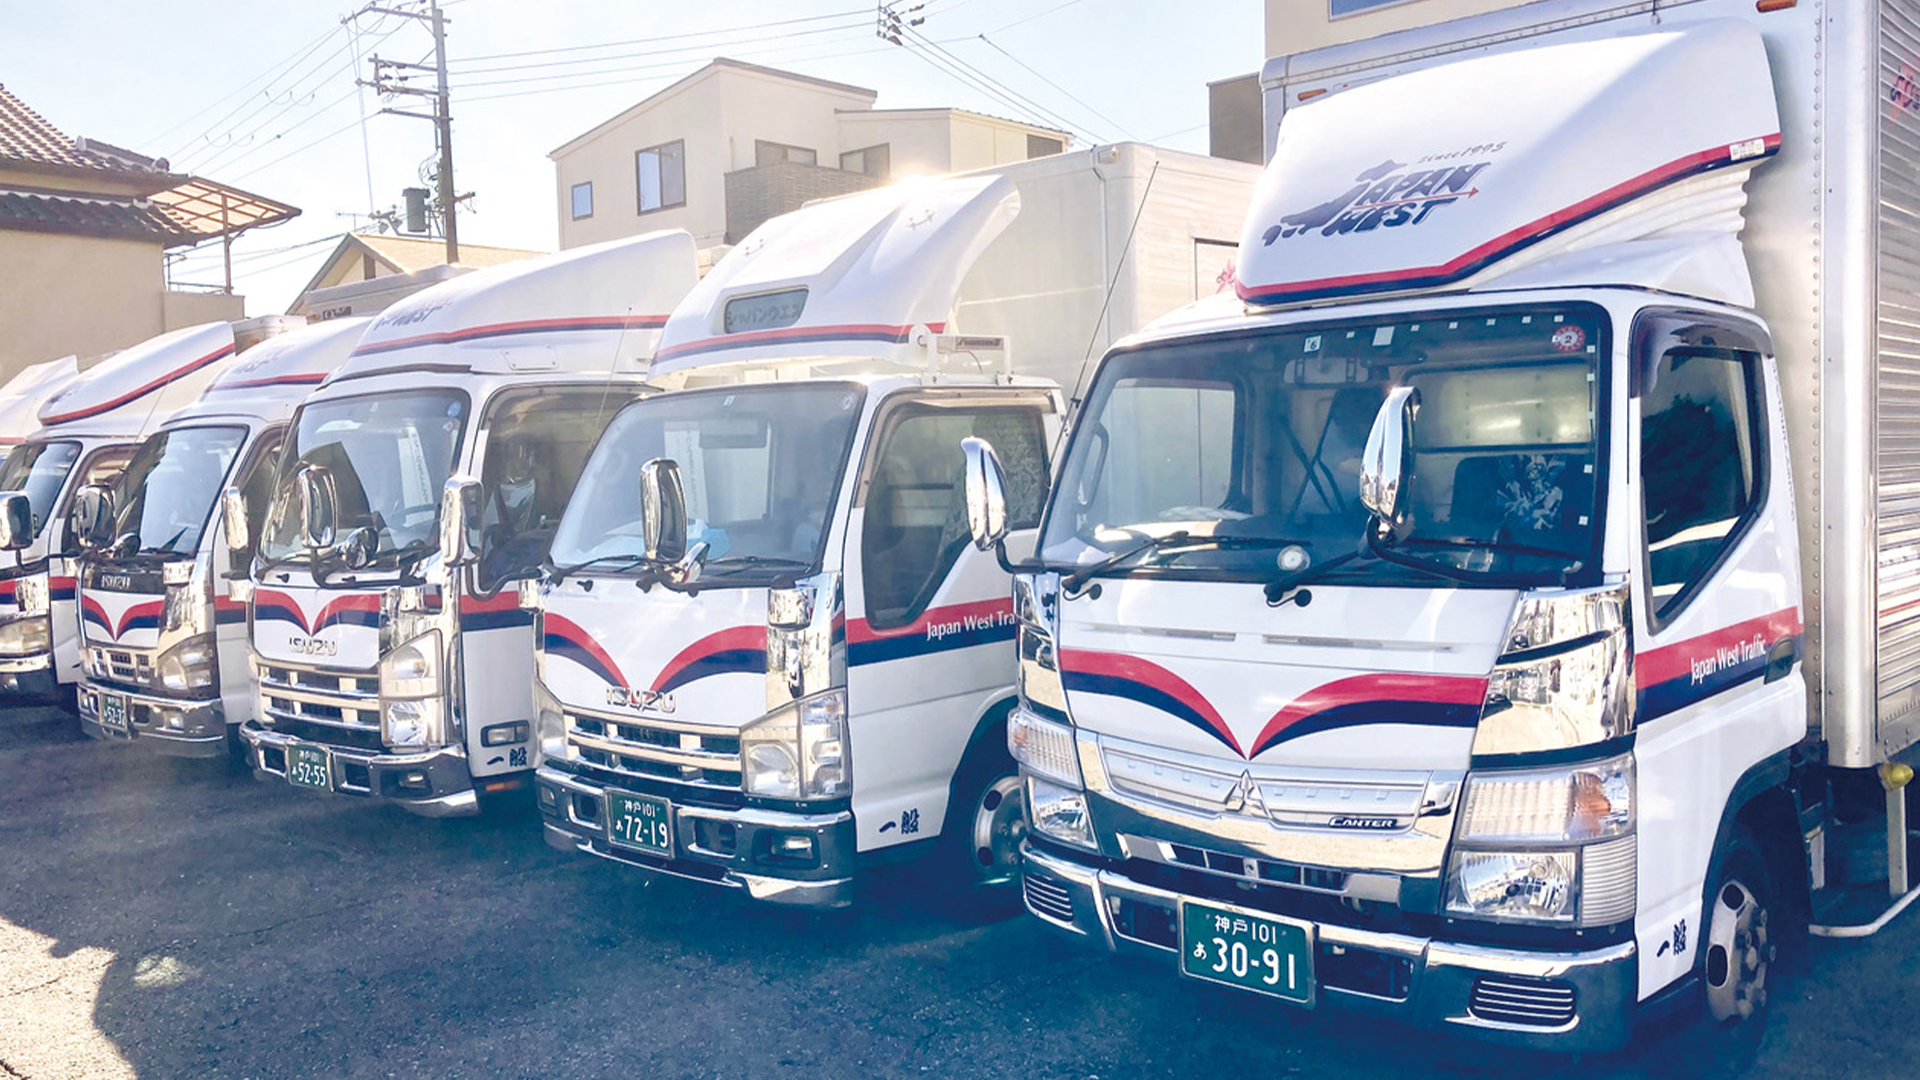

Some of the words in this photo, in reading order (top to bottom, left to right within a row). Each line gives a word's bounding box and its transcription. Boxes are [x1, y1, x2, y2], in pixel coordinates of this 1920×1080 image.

[1321, 197, 1458, 237] WEST
[926, 621, 961, 641] Japan
[963, 613, 994, 632] West
[997, 610, 1016, 626] Tra
[289, 637, 338, 657] ISUZU
[1691, 657, 1716, 687] Japan
[1716, 644, 1740, 670] West
[1740, 633, 1766, 663] Traffic
[606, 687, 676, 714] ISUZU
[486, 746, 527, 767] 一般
[298, 762, 326, 787] 52-55
[624, 814, 668, 848] 72-19
[879, 808, 920, 835] 一般
[1329, 816, 1394, 828] CANTER
[1656, 918, 1687, 957] 一般
[1193, 941, 1207, 960] あ
[1212, 937, 1295, 990] 30-91
